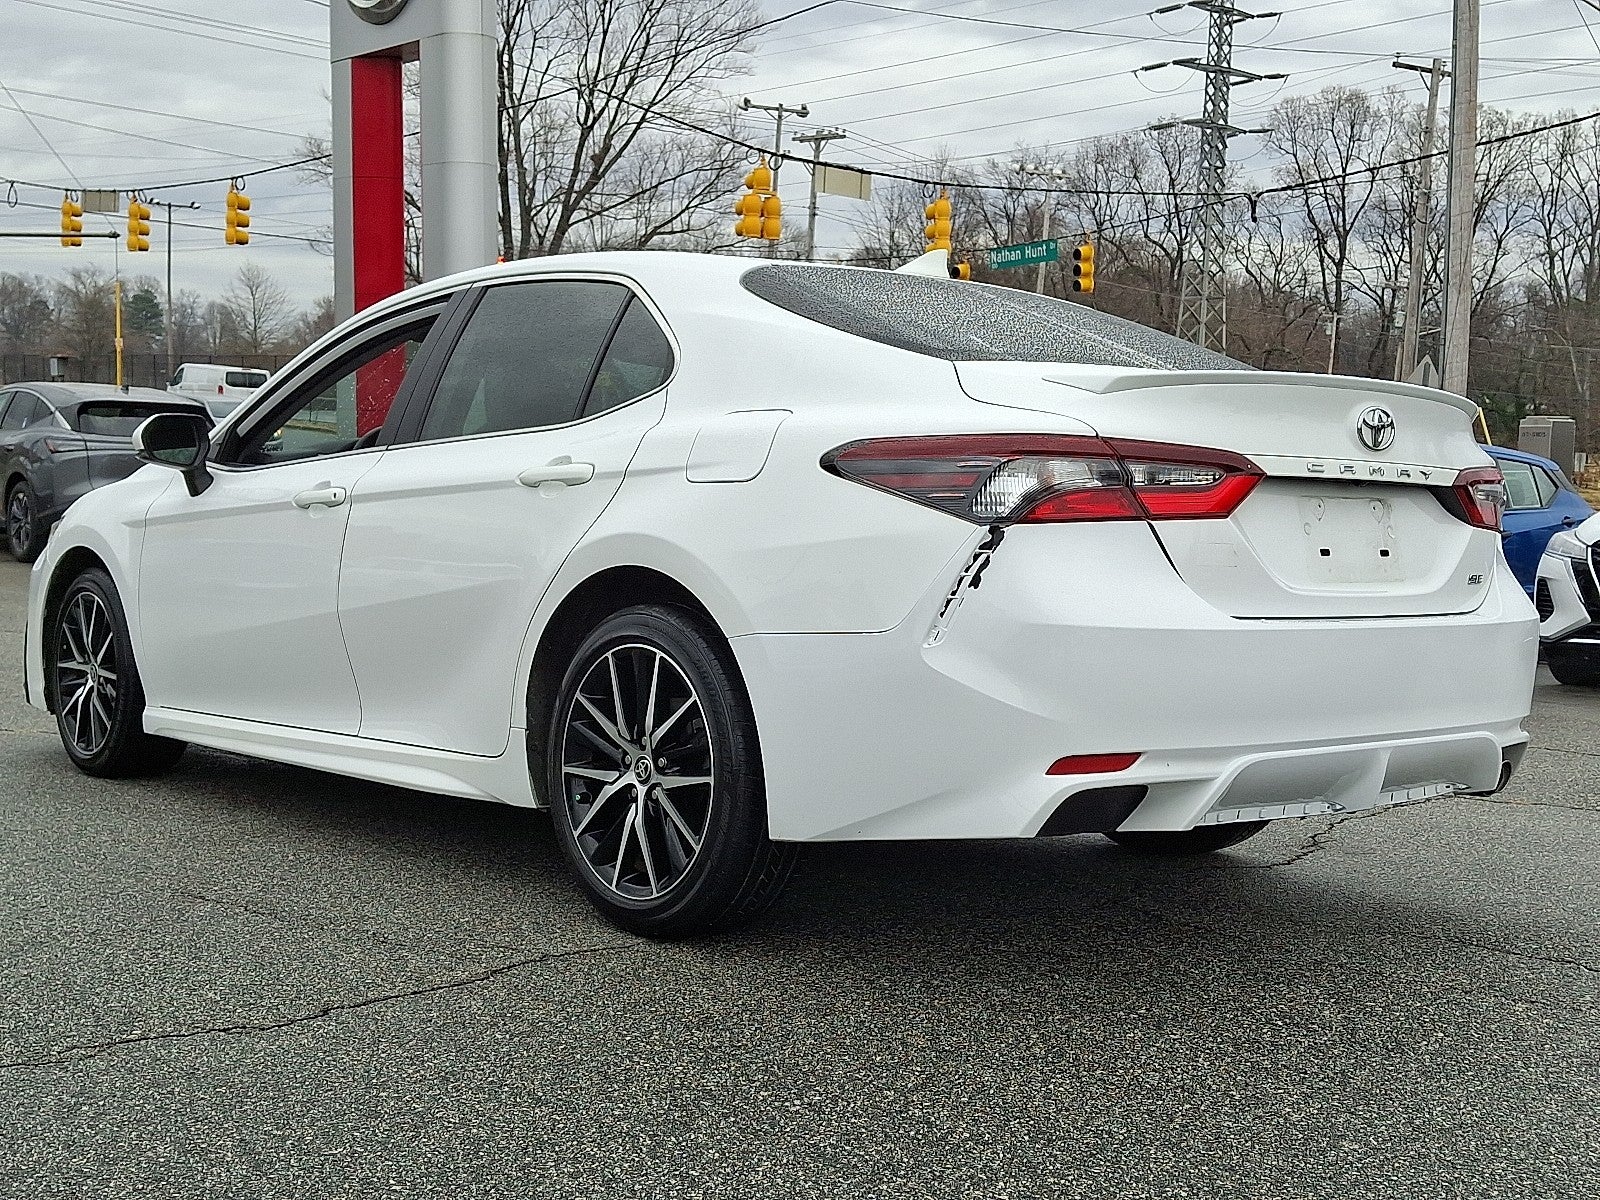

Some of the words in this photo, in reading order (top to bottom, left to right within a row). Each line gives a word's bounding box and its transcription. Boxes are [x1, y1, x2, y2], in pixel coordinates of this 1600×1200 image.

[991, 249, 1021, 263] Nathan
[1025, 244, 1047, 258] Hunt
[1306, 462, 1433, 480] CAMRY
